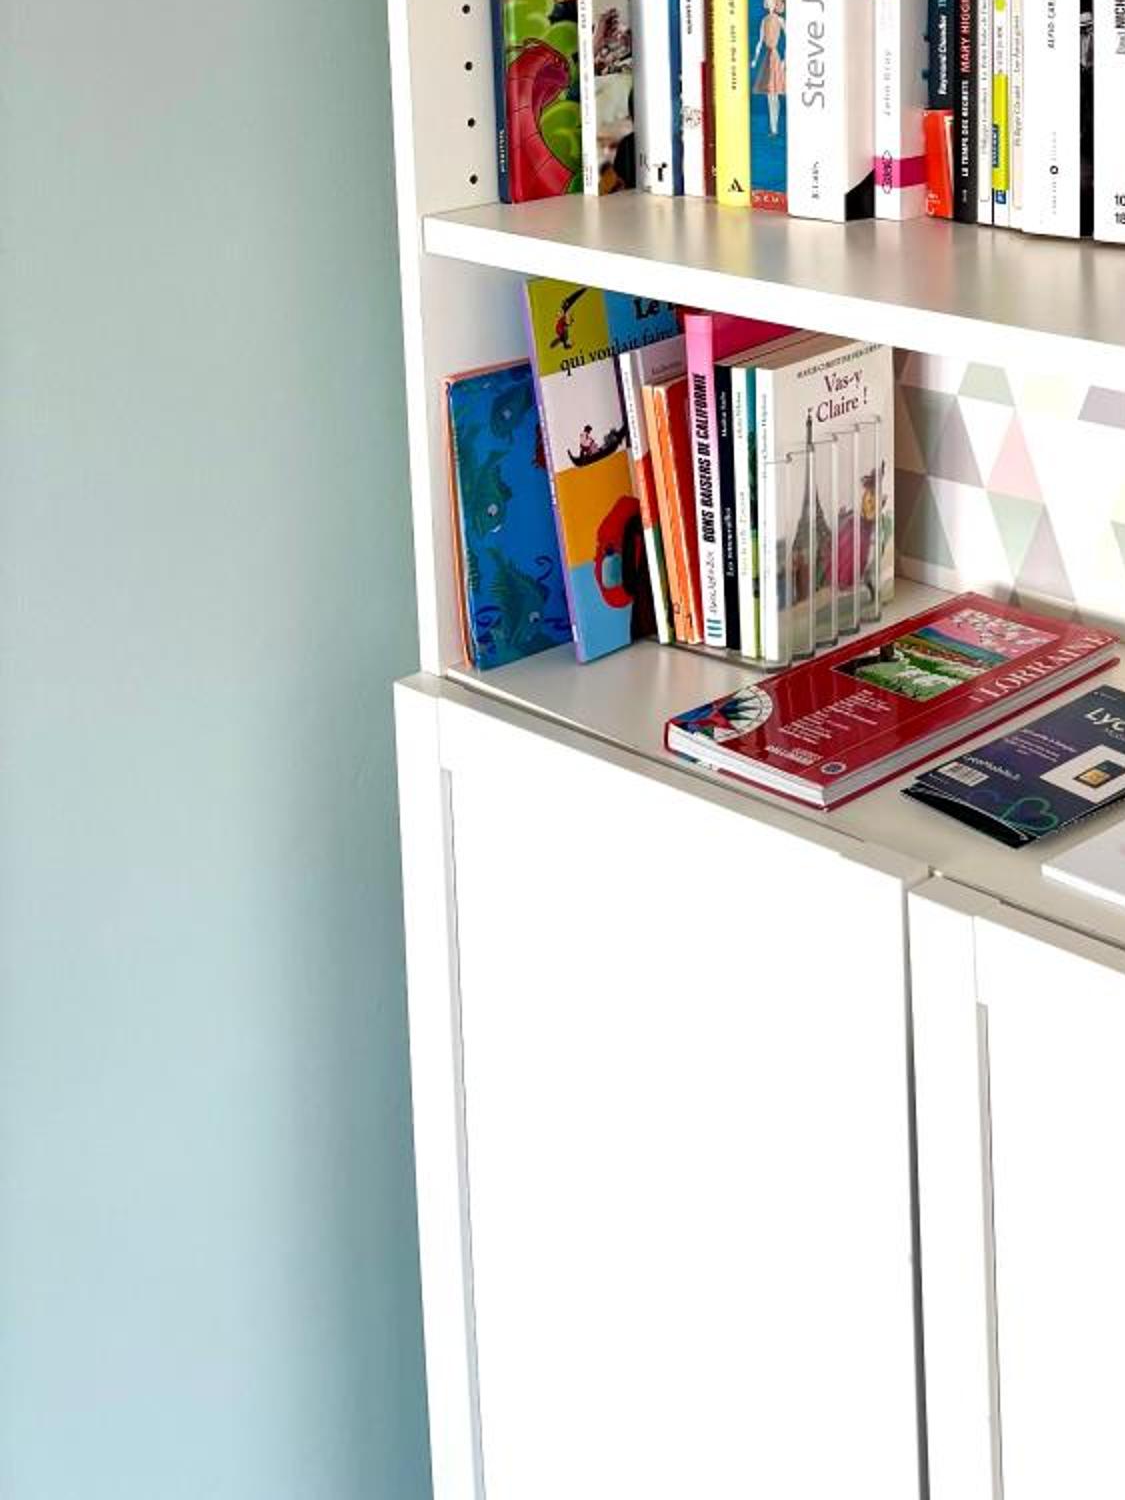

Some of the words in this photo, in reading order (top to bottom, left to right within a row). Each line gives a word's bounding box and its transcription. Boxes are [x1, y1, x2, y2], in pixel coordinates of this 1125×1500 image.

[937, 14, 947, 54] Chandler
[801, 29, 825, 109] Steve
[960, 37, 972, 73] MARY
[559, 349, 586, 377] qui
[588, 336, 641, 364] voulait
[824, 369, 864, 394] Vas-y
[693, 373, 710, 440] CALIFORNIE
[816, 395, 859, 424] Claire
[696, 441, 711, 456] DE
[698, 457, 714, 508] BAISERS
[701, 509, 716, 544] BONS
[979, 635, 1113, 698] LORRAINE
